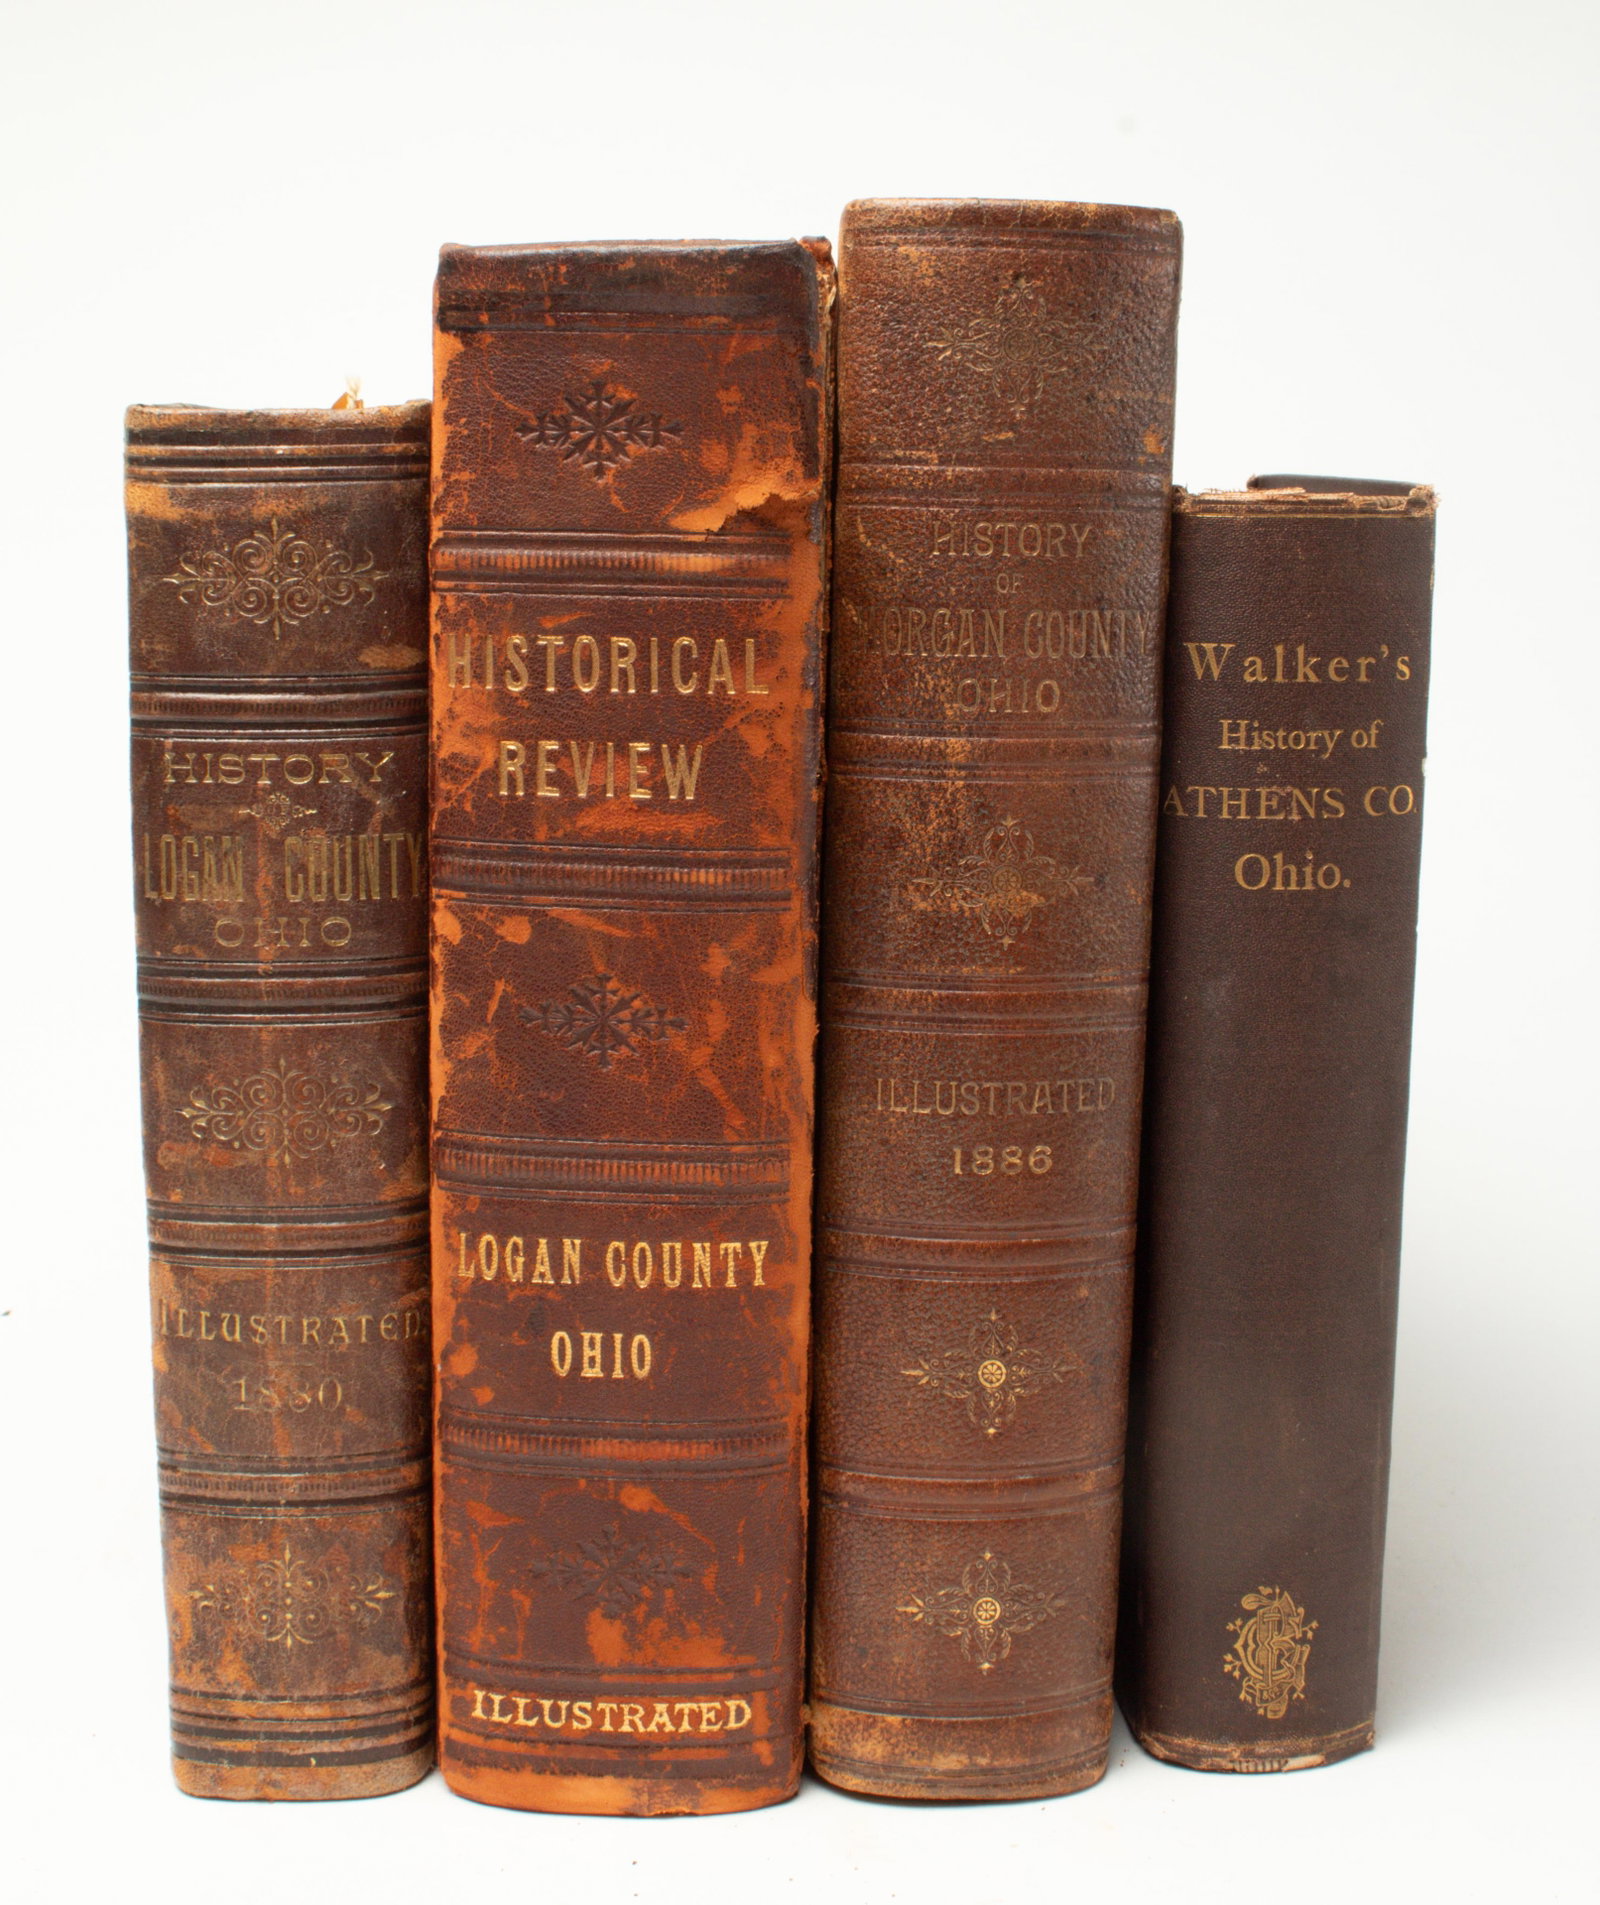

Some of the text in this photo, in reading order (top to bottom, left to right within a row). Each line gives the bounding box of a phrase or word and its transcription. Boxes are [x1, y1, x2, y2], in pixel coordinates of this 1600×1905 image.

[932, 522, 1094, 557] HISTORY
[995, 572, 1025, 594] OF
[448, 633, 769, 694] HISTORICAL
[1184, 642, 1412, 684] Walker's
[957, 678, 1061, 713] OHIO
[1217, 719, 1384, 758] History of
[164, 752, 395, 785] HISTORY
[499, 740, 703, 800] REVIEW
[1163, 784, 1346, 820] ATHENS
[143, 833, 422, 902] LOGAN COUNTY
[1234, 850, 1352, 891] Ohio.
[215, 916, 351, 947] OHIO
[876, 1077, 1115, 1115] ILLUSTRATED
[953, 1145, 1052, 1176] 1886
[457, 1233, 769, 1288] LOGAN COUNTY
[550, 1330, 652, 1379] OHIO
[471, 1689, 752, 1733] ILLUSTRATED
